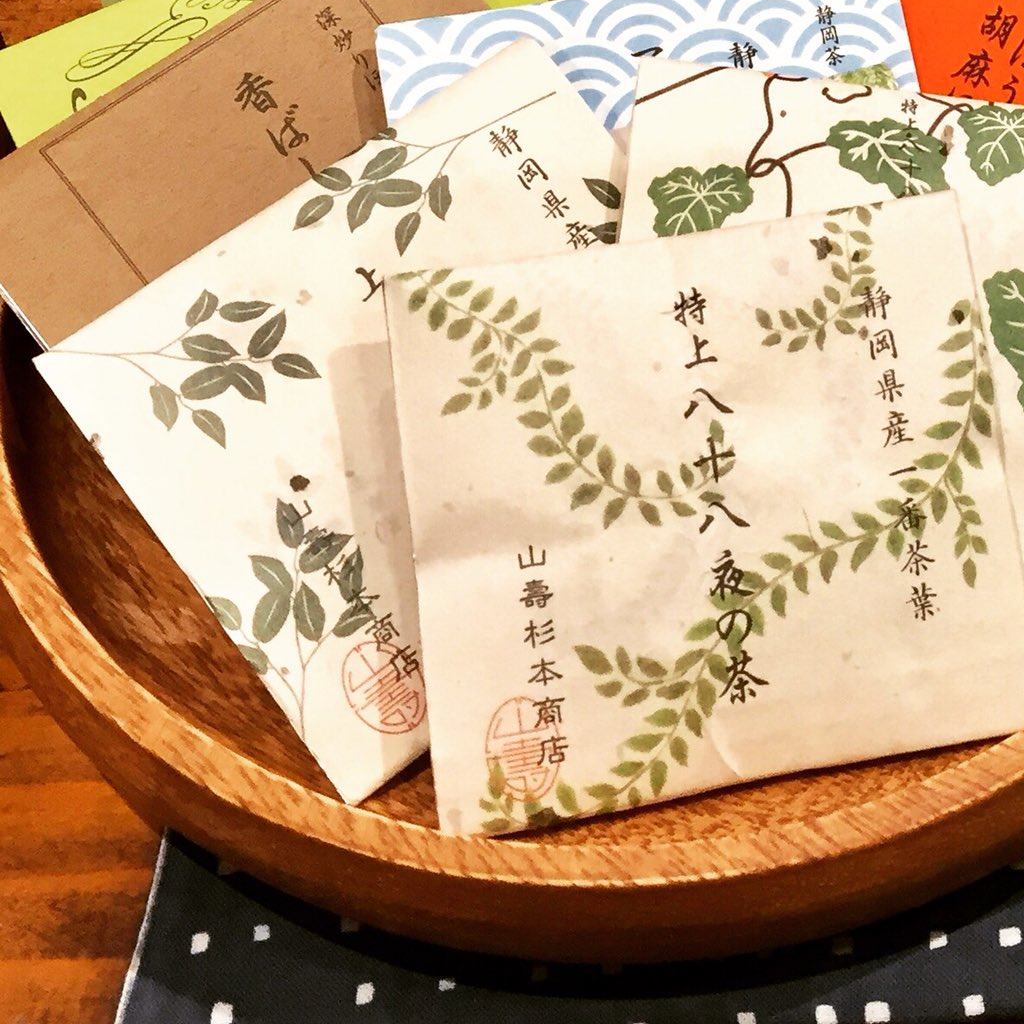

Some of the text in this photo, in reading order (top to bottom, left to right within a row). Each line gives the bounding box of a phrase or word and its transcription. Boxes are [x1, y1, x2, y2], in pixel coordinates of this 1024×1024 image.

[816, 5, 846, 66] 静岡茶
[951, 5, 1018, 98] 胡麻
[674, 286, 769, 704] 特上八十八夜の茶
[863, 286, 938, 621] 静岡県産一番茶葉
[518, 545, 569, 765] 山壽杉本商店
